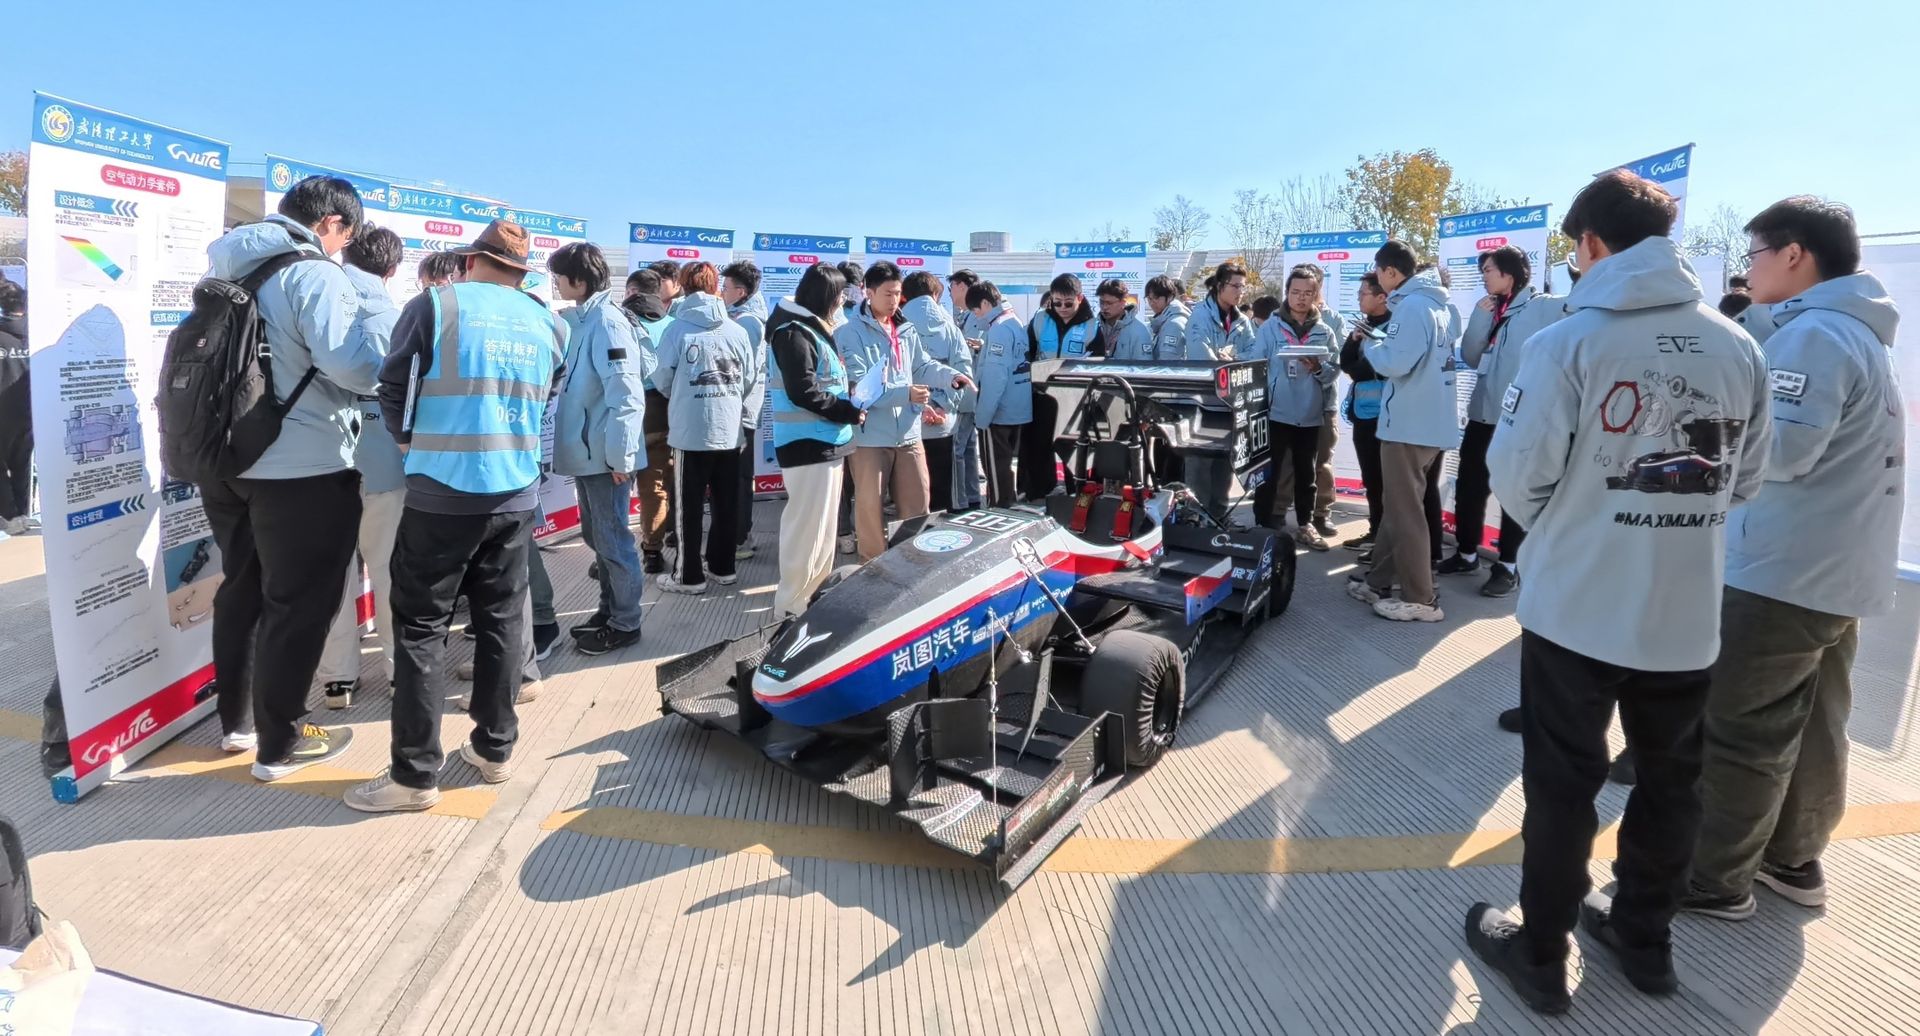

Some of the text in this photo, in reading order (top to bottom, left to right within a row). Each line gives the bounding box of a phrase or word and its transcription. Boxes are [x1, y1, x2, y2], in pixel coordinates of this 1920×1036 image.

[106, 169, 176, 193] 空气动力学套件
[1656, 333, 1704, 353] EVE
[496, 405, 529, 426] 064
[1614, 511, 1705, 529] #MAXIMUM
[892, 616, 971, 681] 岚图汽车
